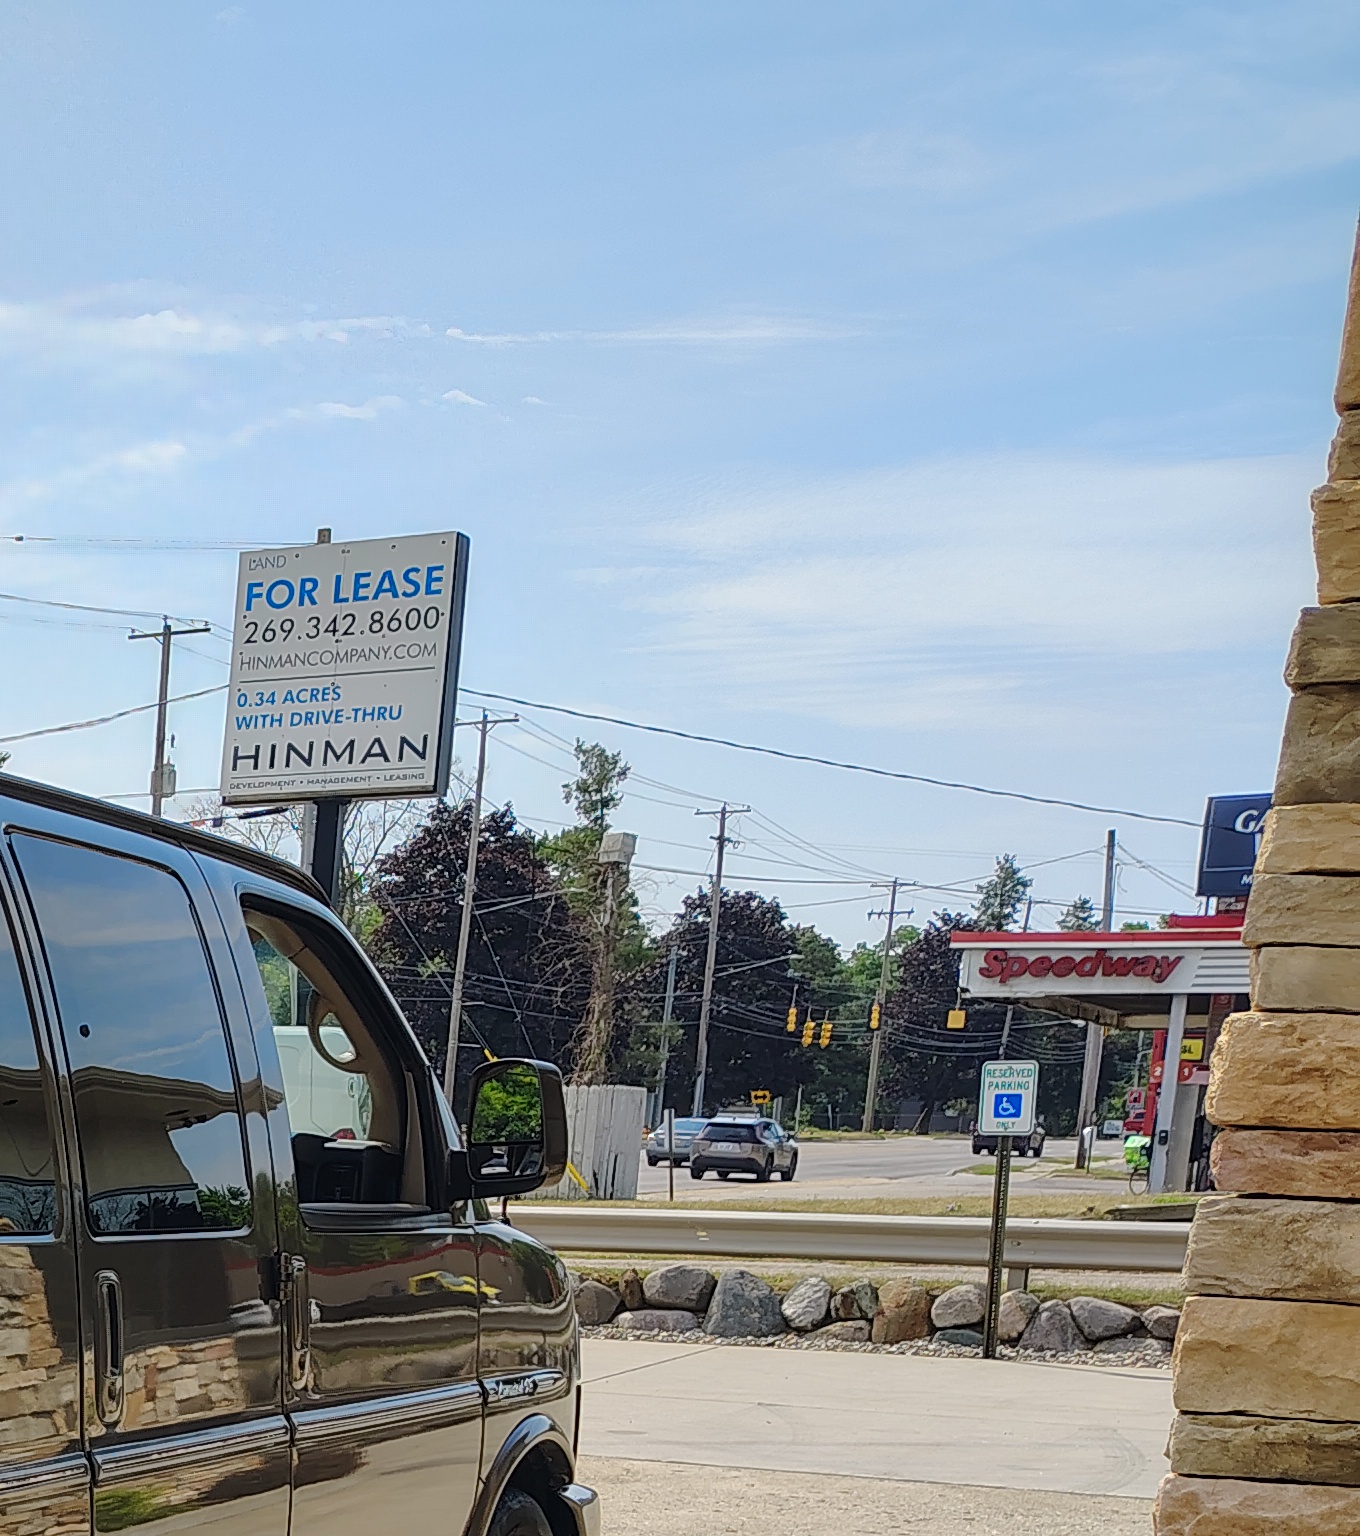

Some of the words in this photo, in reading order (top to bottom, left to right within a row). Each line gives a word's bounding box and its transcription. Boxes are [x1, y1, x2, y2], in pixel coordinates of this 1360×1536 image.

[249, 555, 286, 571] LAND
[245, 577, 319, 611] FOR
[333, 565, 444, 604] LEASE
[243, 606, 440, 644] 269.342.8600
[239, 642, 437, 671] HINMANCOMPANY.COM
[237, 690, 276, 707] 0.34
[282, 686, 341, 705] ACRES
[235, 712, 283, 730] WITH
[289, 705, 403, 727] DRIVE-THRU
[231, 734, 429, 771] HINMAN
[230, 779, 296, 790] DEVELOPMENT
[307, 775, 371, 785] MANAGEMENT
[384, 772, 425, 782] LEASING
[979, 949, 1184, 984] Speedway
[987, 1068, 1033, 1078] RESERVED
[988, 1080, 1030, 1091] PARKING
[996, 1121, 1016, 1129] ONLY
